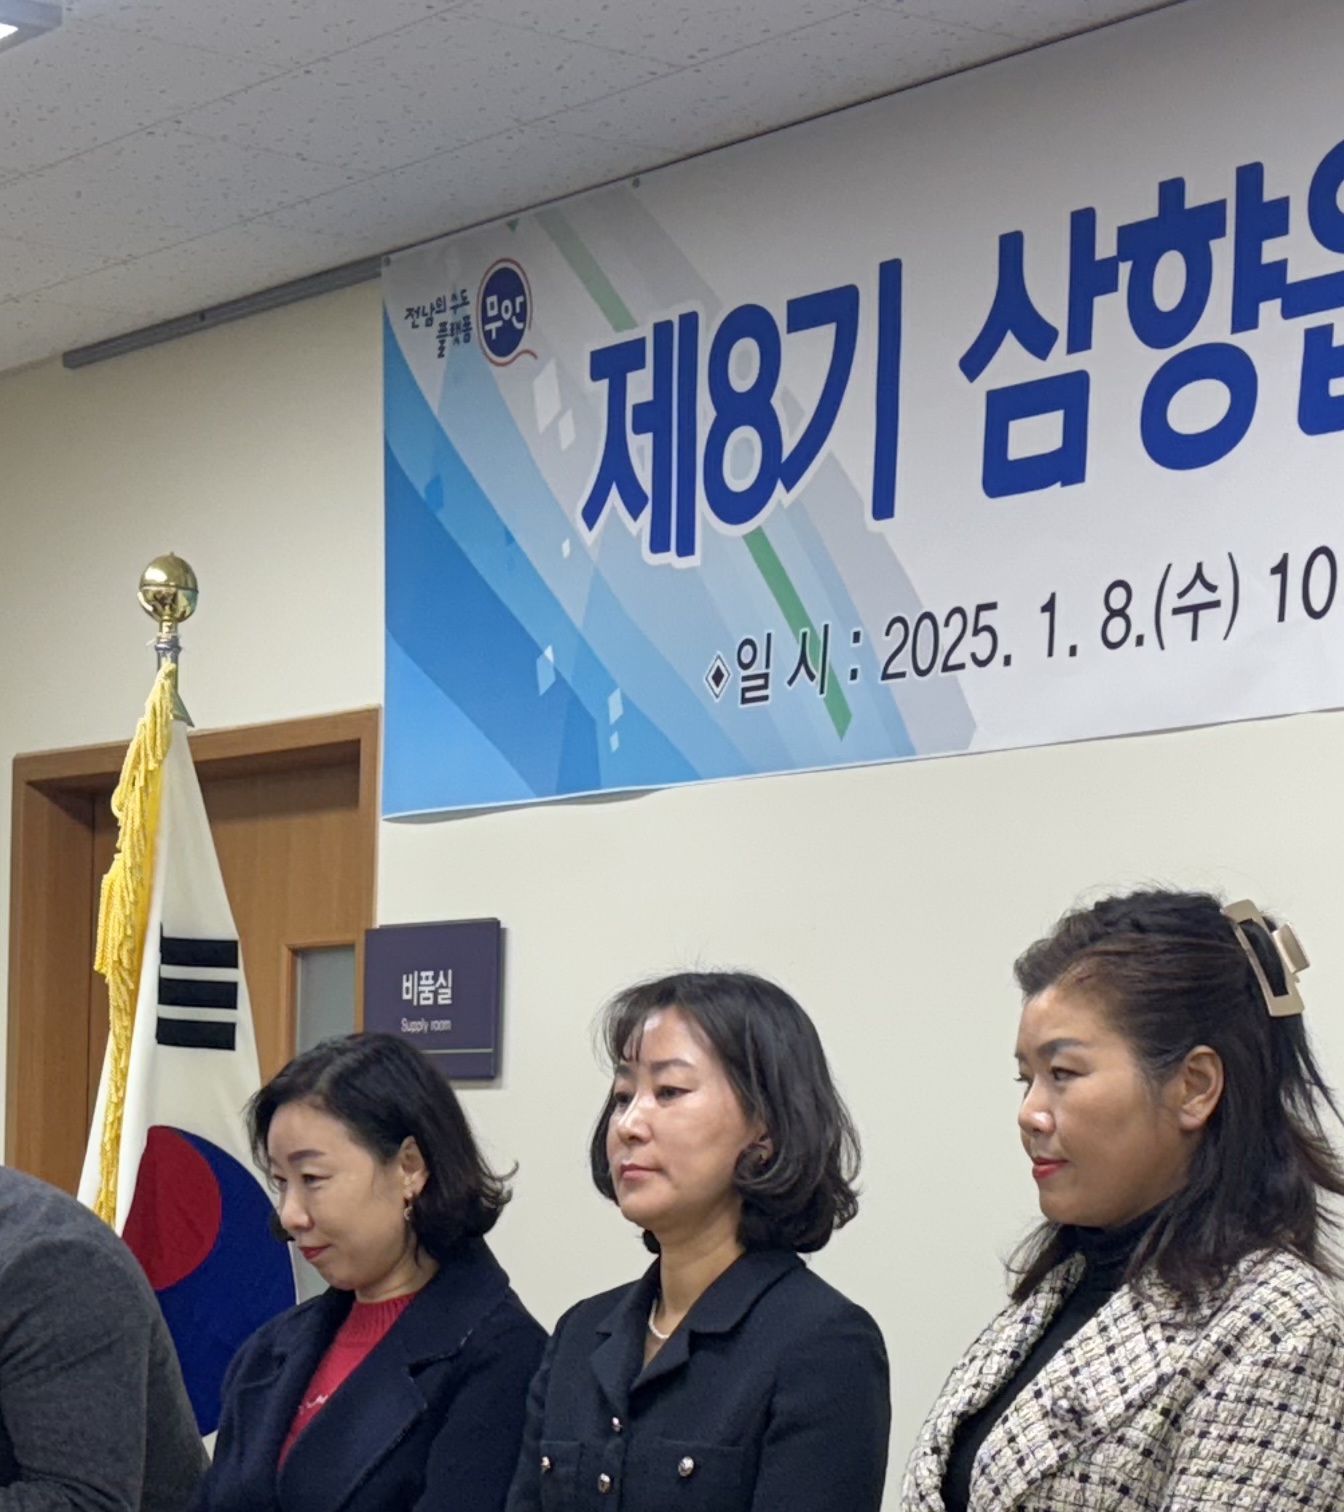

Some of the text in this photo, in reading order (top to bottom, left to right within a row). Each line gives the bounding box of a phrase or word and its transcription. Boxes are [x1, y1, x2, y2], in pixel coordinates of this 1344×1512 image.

[404, 295, 447, 329] 전남의
[483, 294, 526, 340] 무안
[581, 258, 903, 558] 제8기
[879, 600, 1013, 682] 2025.
[1039, 591, 1078, 659] 1.
[1100, 551, 1240, 652] 8.(수)
[401, 968, 453, 1007] 비품실
[400, 1017, 452, 1034] Supply room
